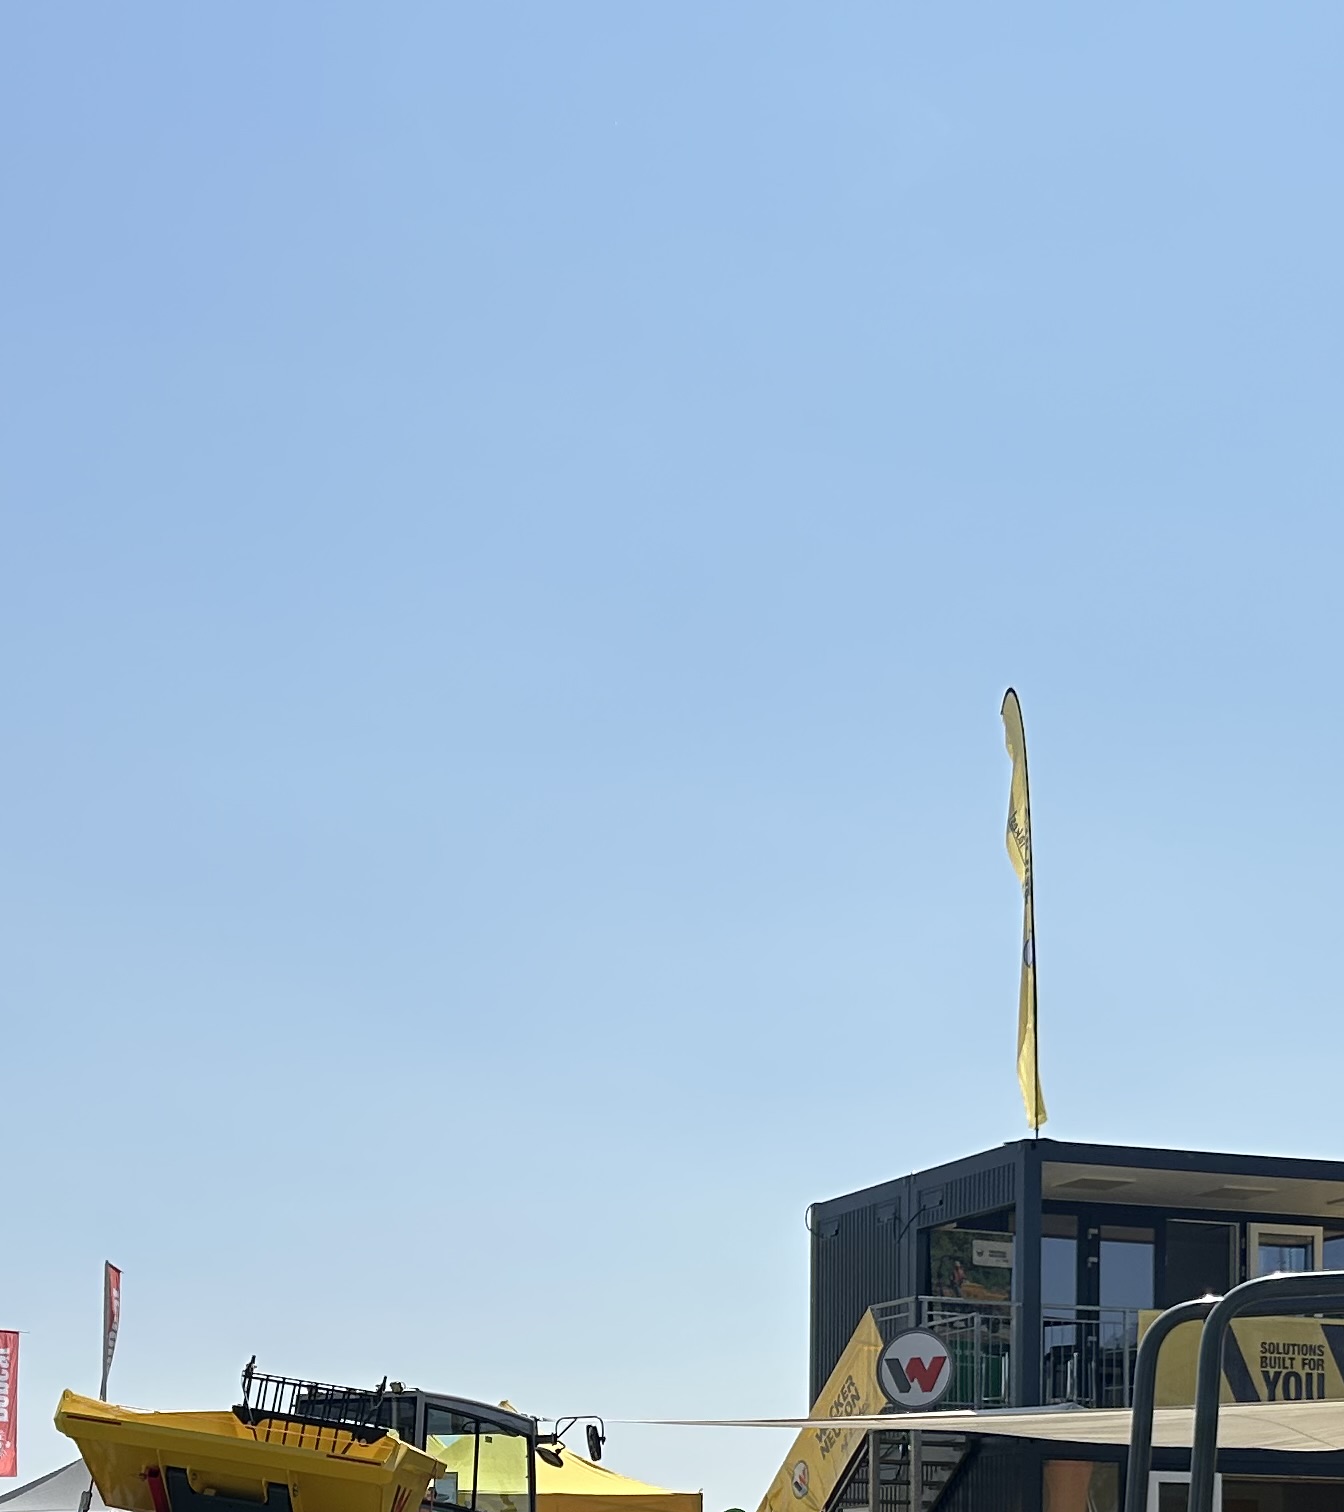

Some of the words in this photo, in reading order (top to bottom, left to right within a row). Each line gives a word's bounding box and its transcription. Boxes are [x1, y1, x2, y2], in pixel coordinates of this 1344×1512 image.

[1260, 1342, 1325, 1356] SOLUTIONS
[1260, 1356, 1295, 1369] BUILT
[1302, 1358, 1324, 1371] FOR
[1261, 1370, 1325, 1401] YOU
